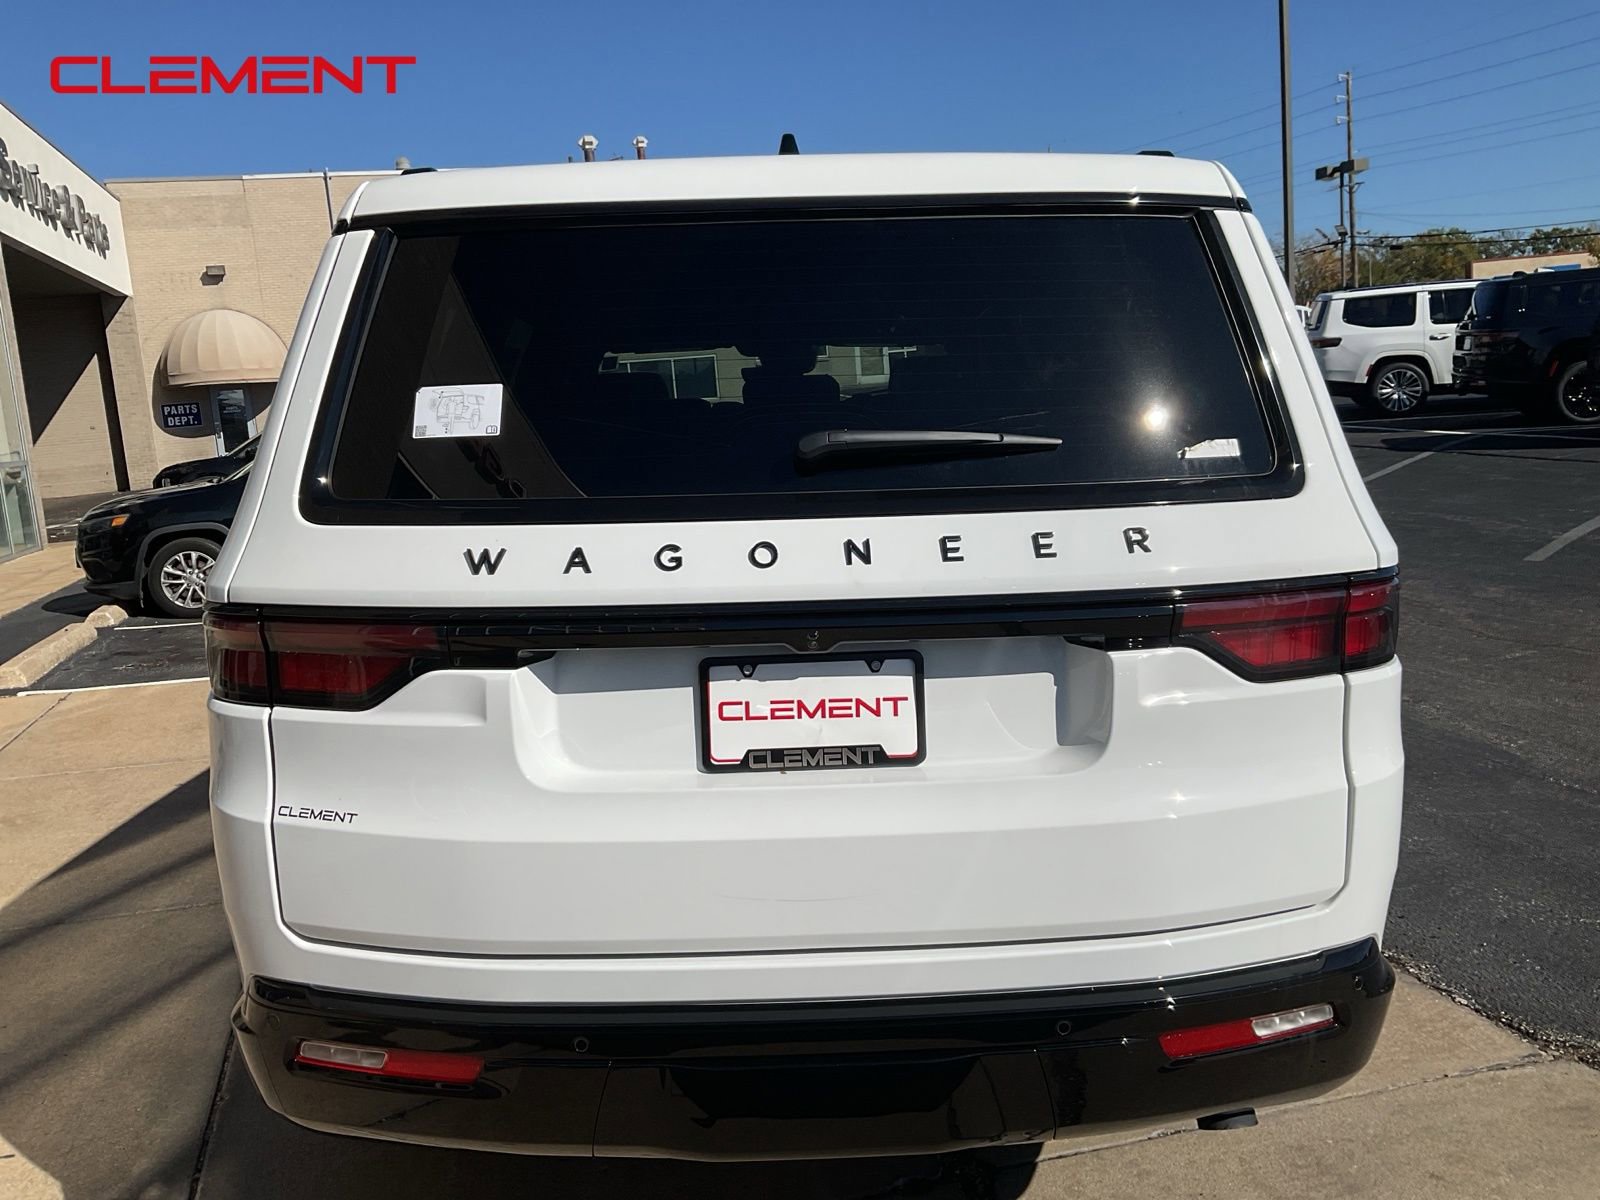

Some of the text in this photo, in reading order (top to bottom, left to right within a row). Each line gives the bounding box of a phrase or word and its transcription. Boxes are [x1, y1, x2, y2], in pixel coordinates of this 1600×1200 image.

[70, 194, 110, 252] Parts
[163, 404, 198, 416] PARTS
[167, 416, 198, 426] DEPT.
[463, 527, 1152, 576] WAGONEER
[718, 697, 908, 721] CLEMENT
[749, 747, 880, 769] CLEMENT
[278, 805, 358, 824] CLEMENT
